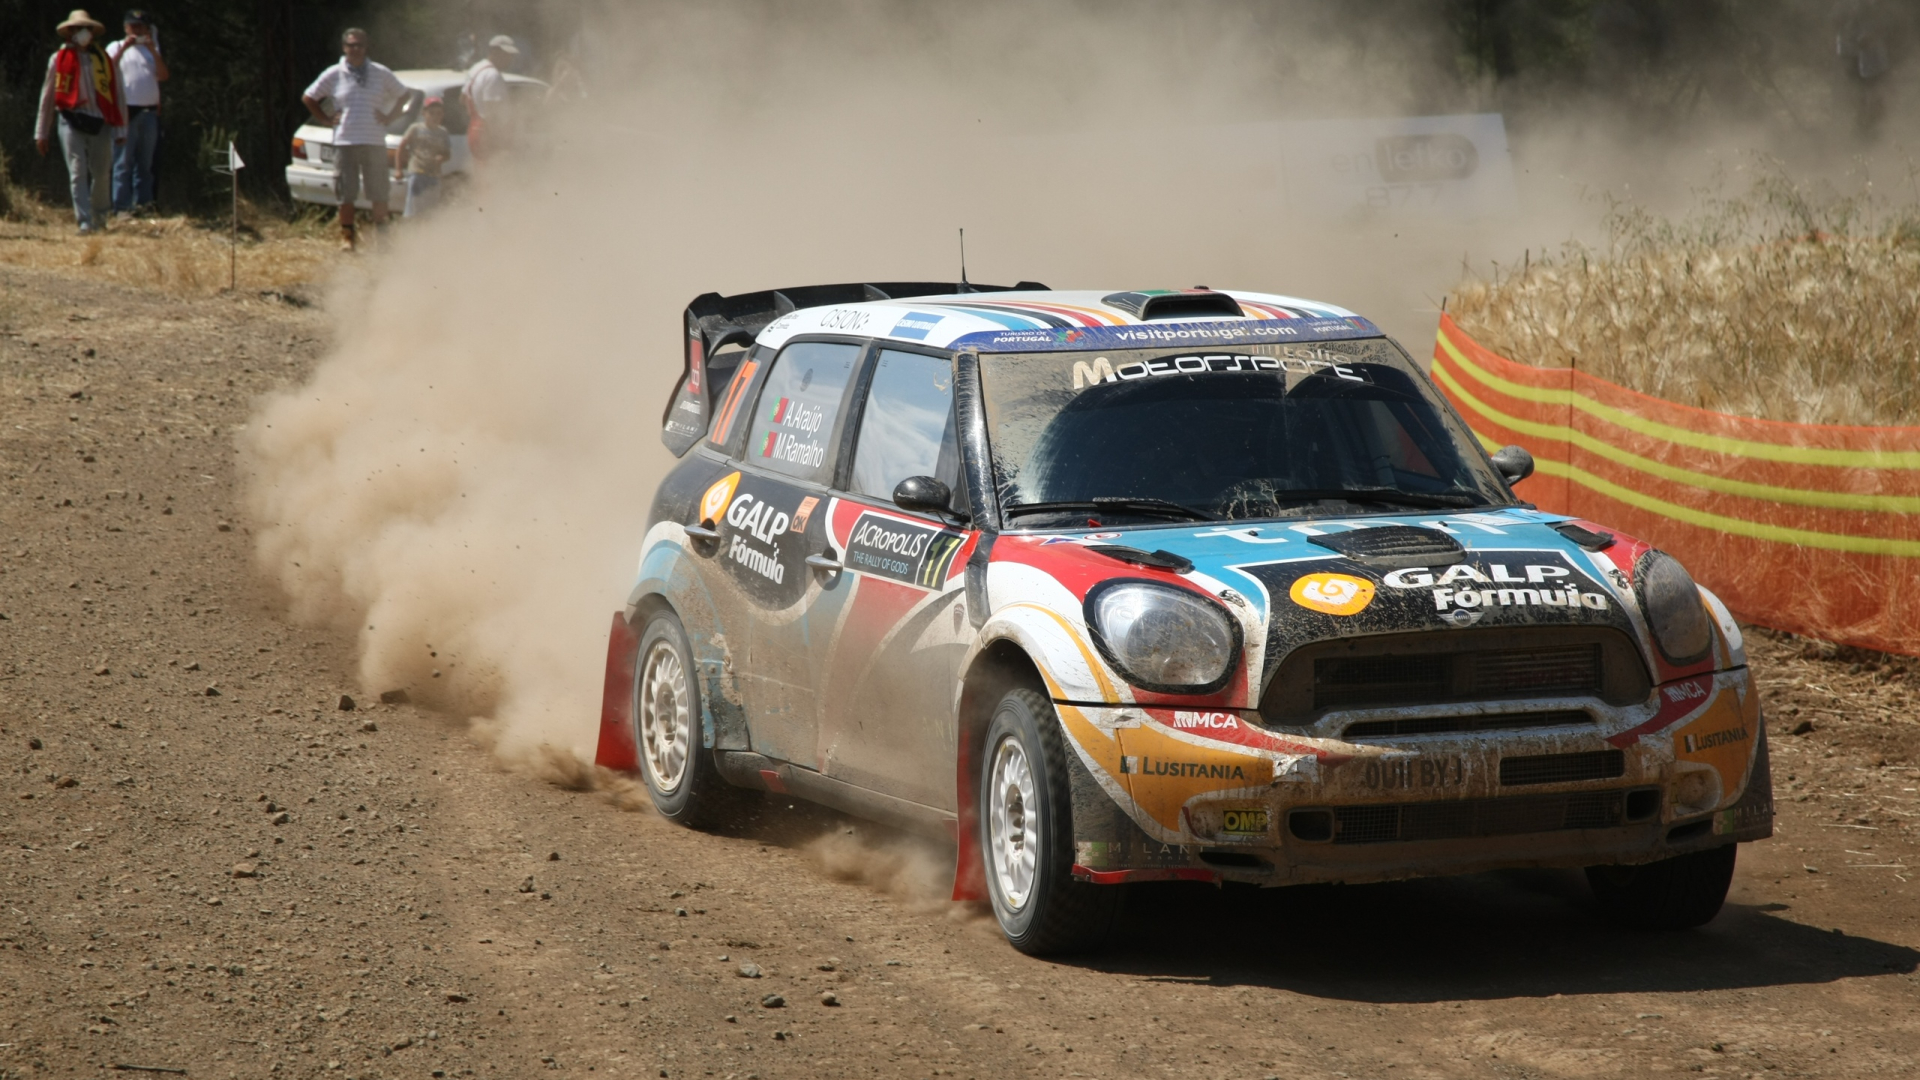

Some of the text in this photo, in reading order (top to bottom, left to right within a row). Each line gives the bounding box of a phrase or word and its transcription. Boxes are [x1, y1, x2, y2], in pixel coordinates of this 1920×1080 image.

[773, 432, 824, 468] M.Ramalho
[727, 493, 789, 545] GALP
[793, 515, 806, 531] OK
[853, 521, 927, 557] ACROPOLIS
[728, 534, 784, 585] Fórmula
[854, 551, 909, 575] THE RALLY OF GODS
[923, 535, 961, 588] 17
[1383, 564, 1570, 588] GALP
[1433, 586, 1607, 611] Fórmula
[1193, 711, 1238, 729] MCA
[1223, 811, 1268, 831] OMP
